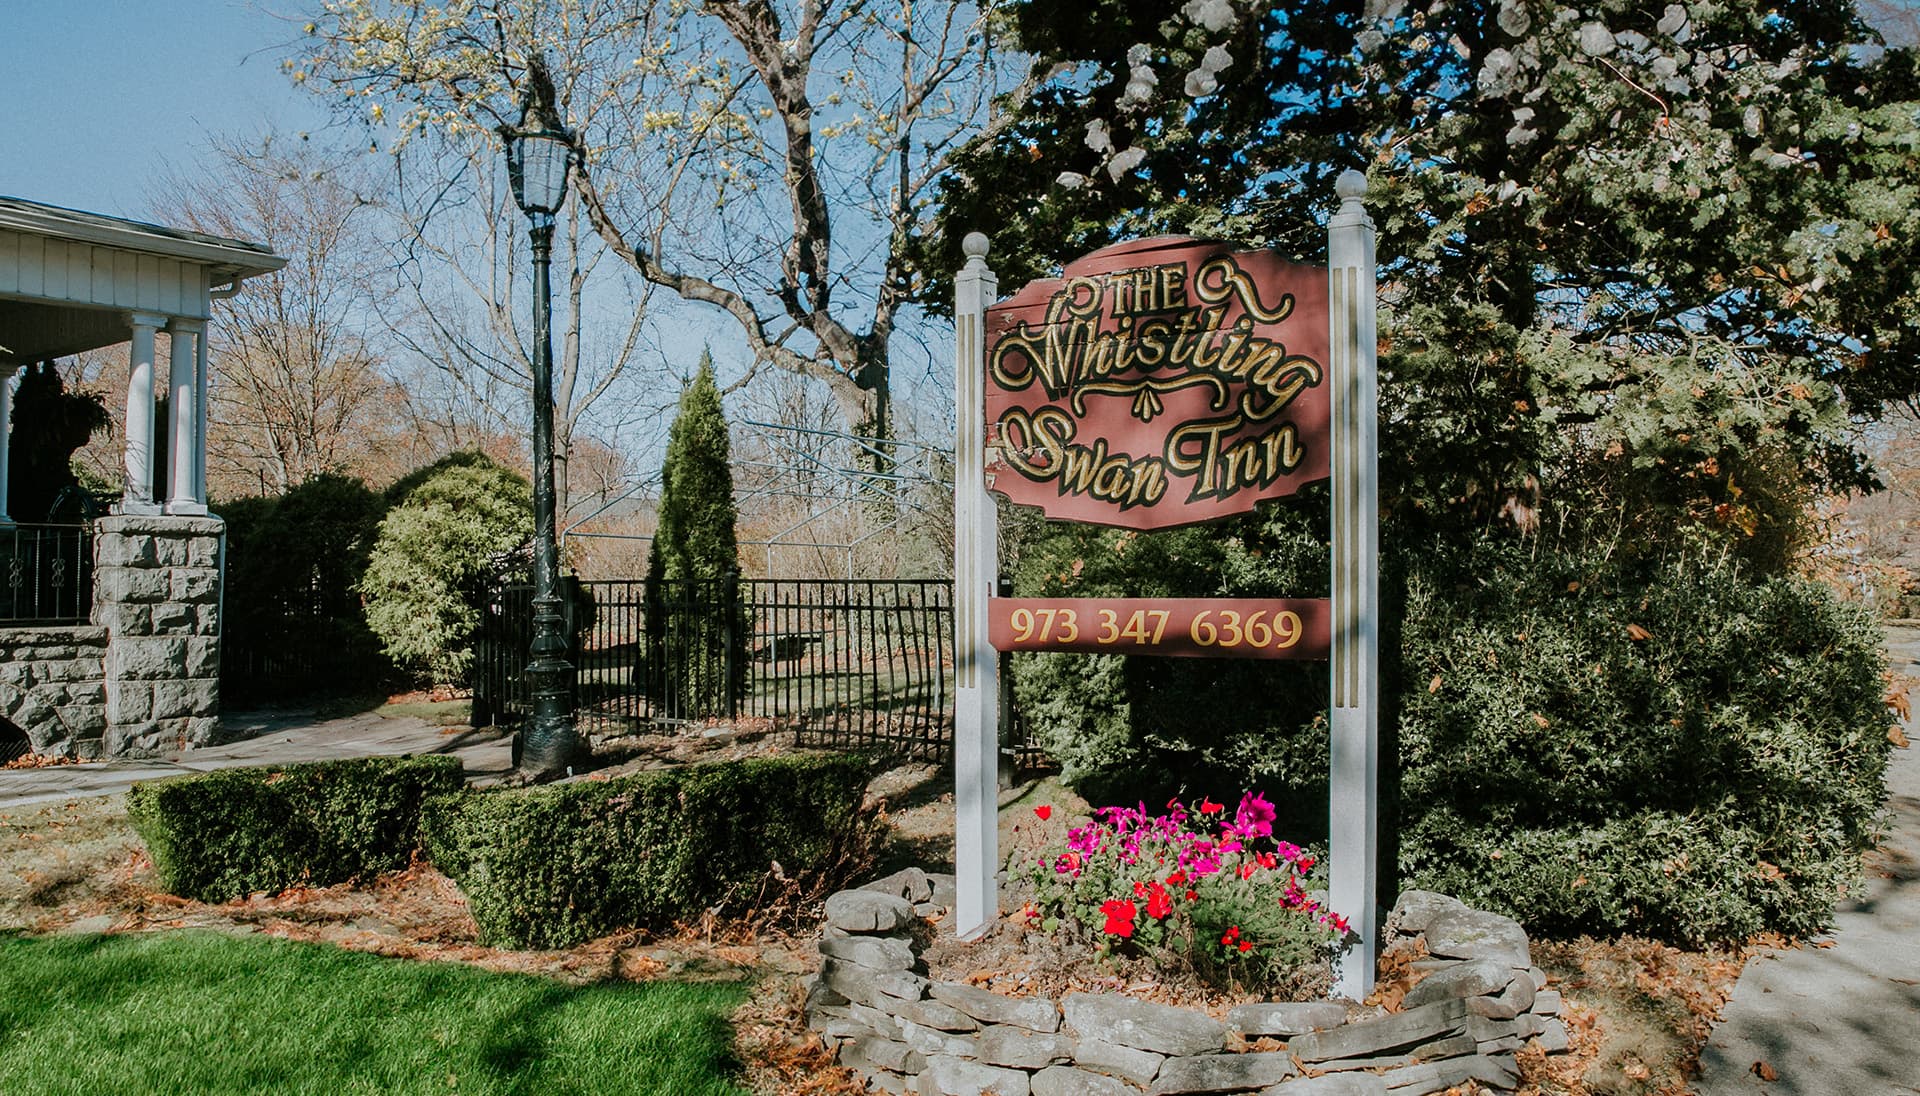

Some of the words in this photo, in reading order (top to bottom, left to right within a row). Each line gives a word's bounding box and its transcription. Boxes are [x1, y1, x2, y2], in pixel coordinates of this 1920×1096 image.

[1106, 263, 1187, 317] THE
[991, 276, 1321, 420] Whistling
[999, 408, 1168, 505] Swan
[1166, 413, 1304, 499] Inn
[1009, 608, 1079, 643] 973
[1097, 608, 1171, 645] 347
[1190, 609, 1303, 649] 6369
